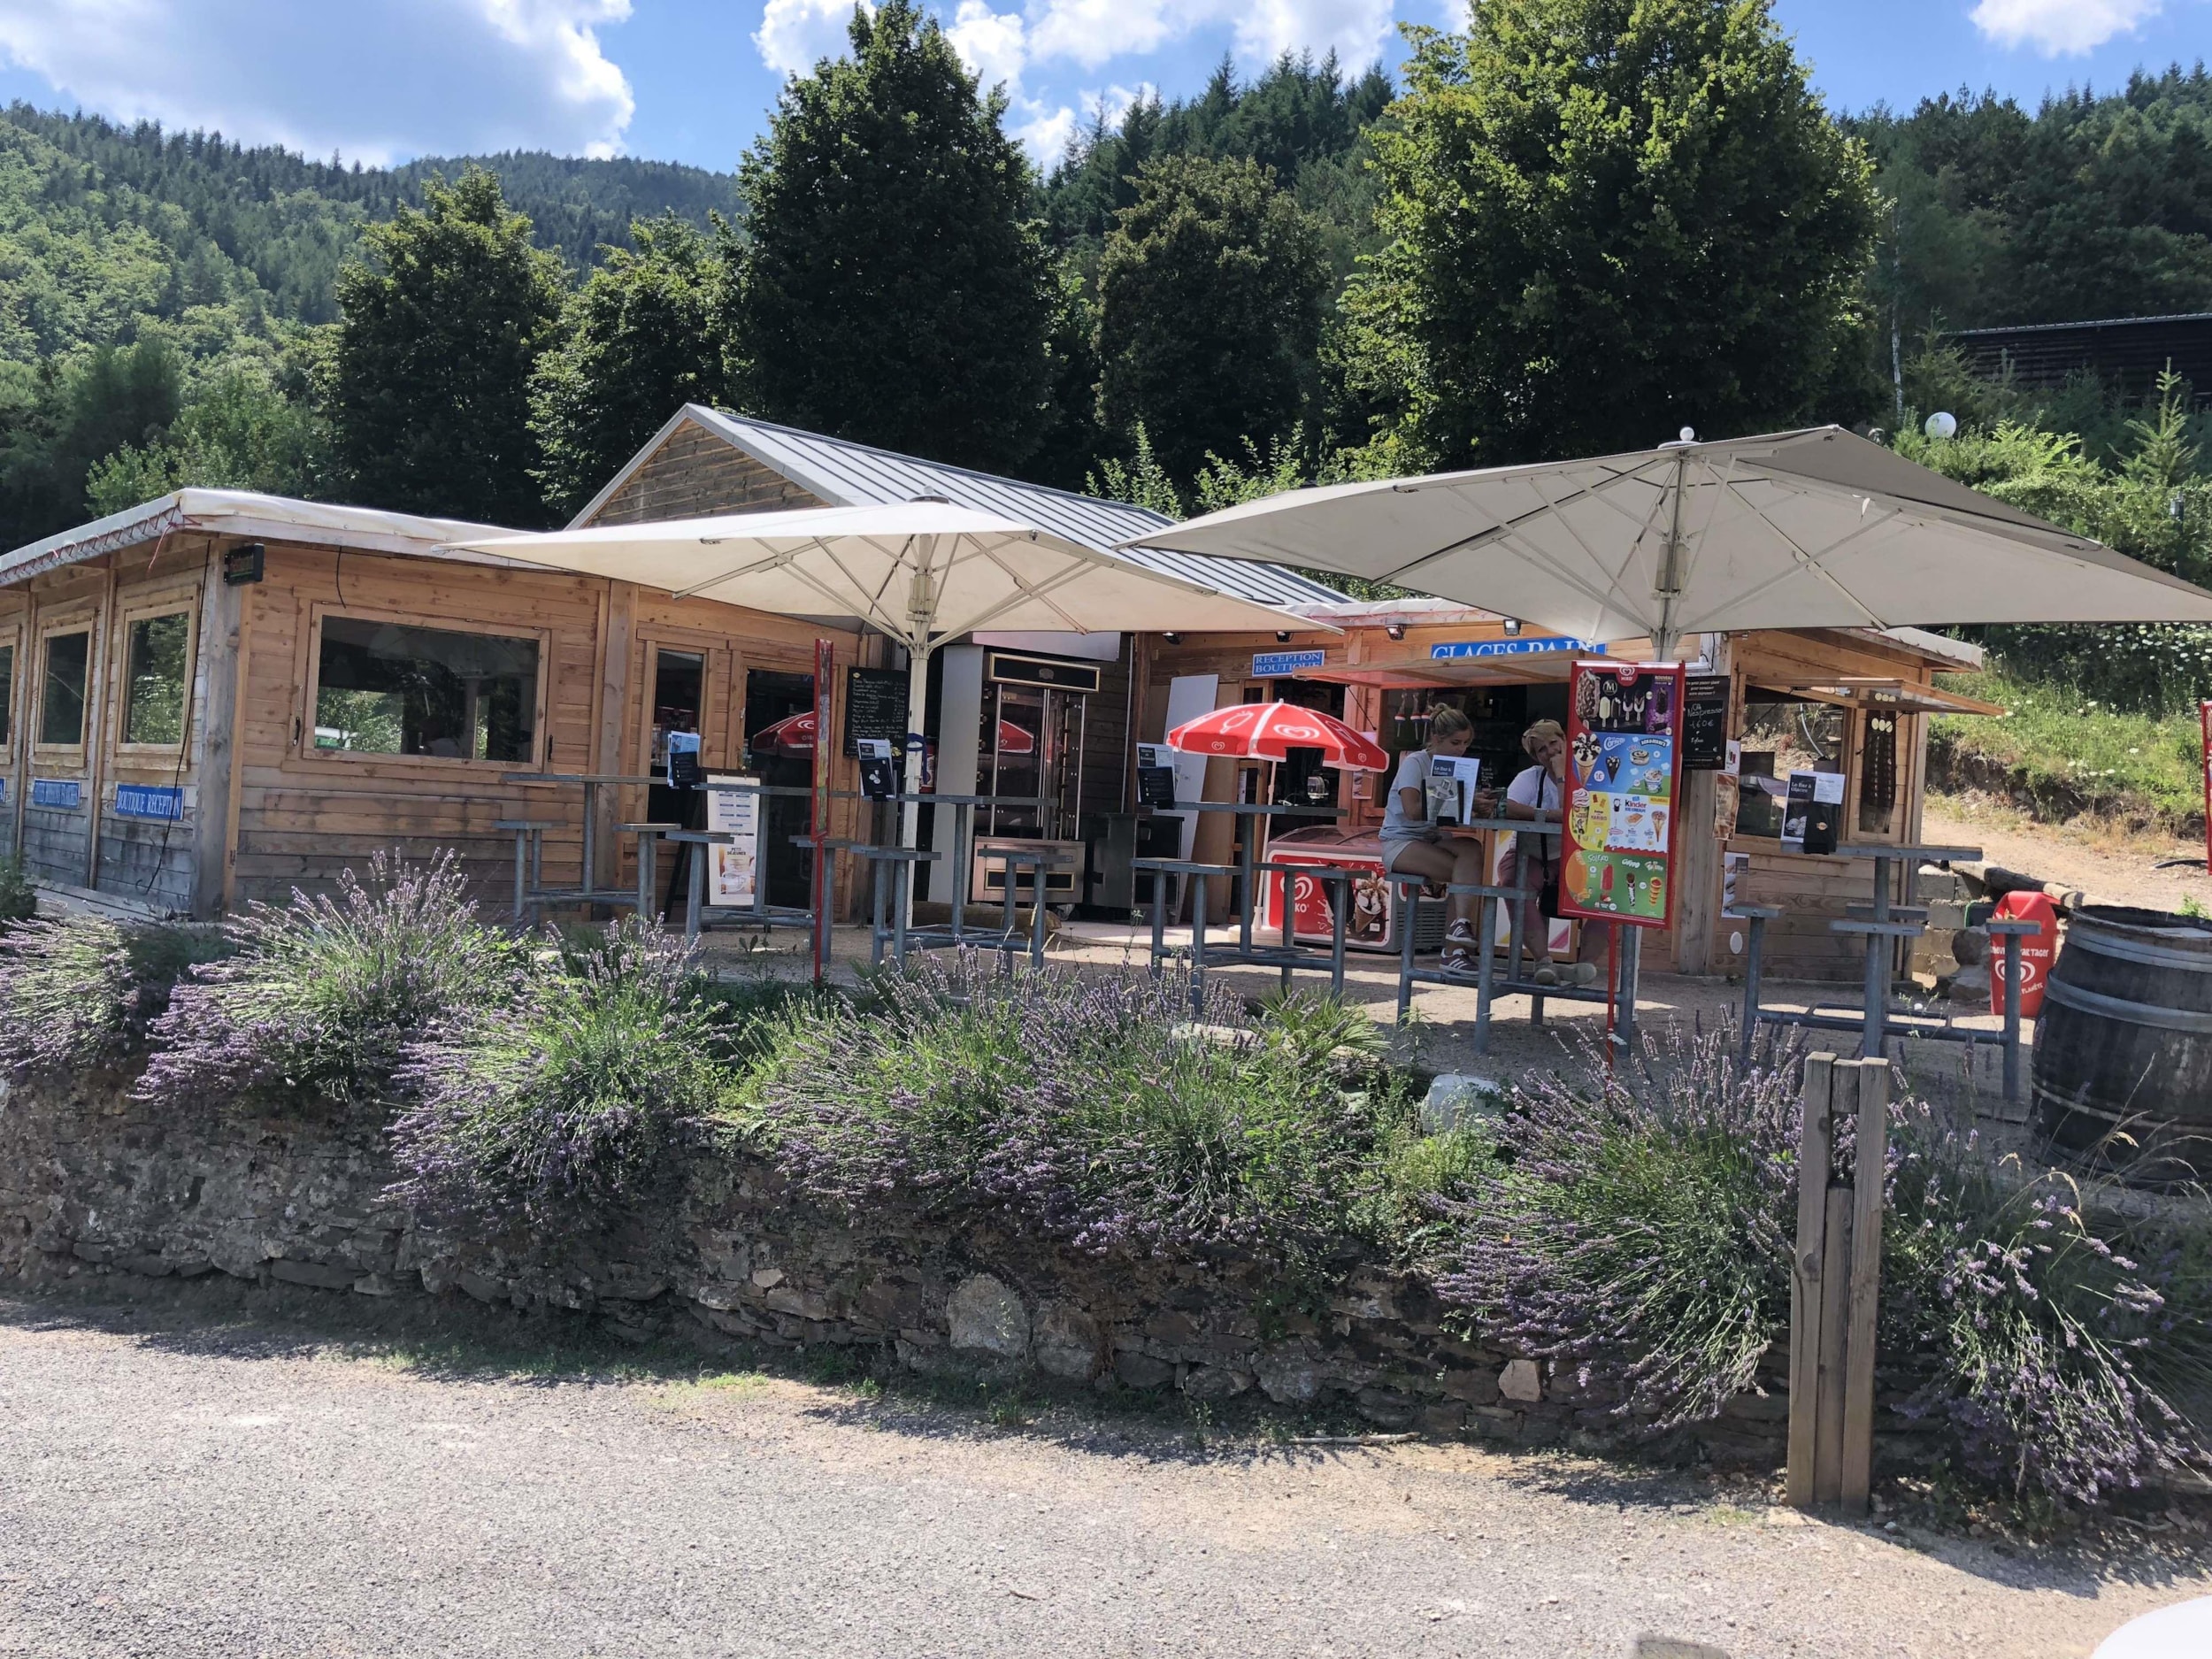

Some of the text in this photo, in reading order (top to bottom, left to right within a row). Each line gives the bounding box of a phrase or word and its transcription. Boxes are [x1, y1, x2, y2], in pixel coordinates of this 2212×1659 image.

[1256, 653, 1321, 664] RECEPTION
[116, 790, 181, 816] BOUTIQUE RECEPTIN
